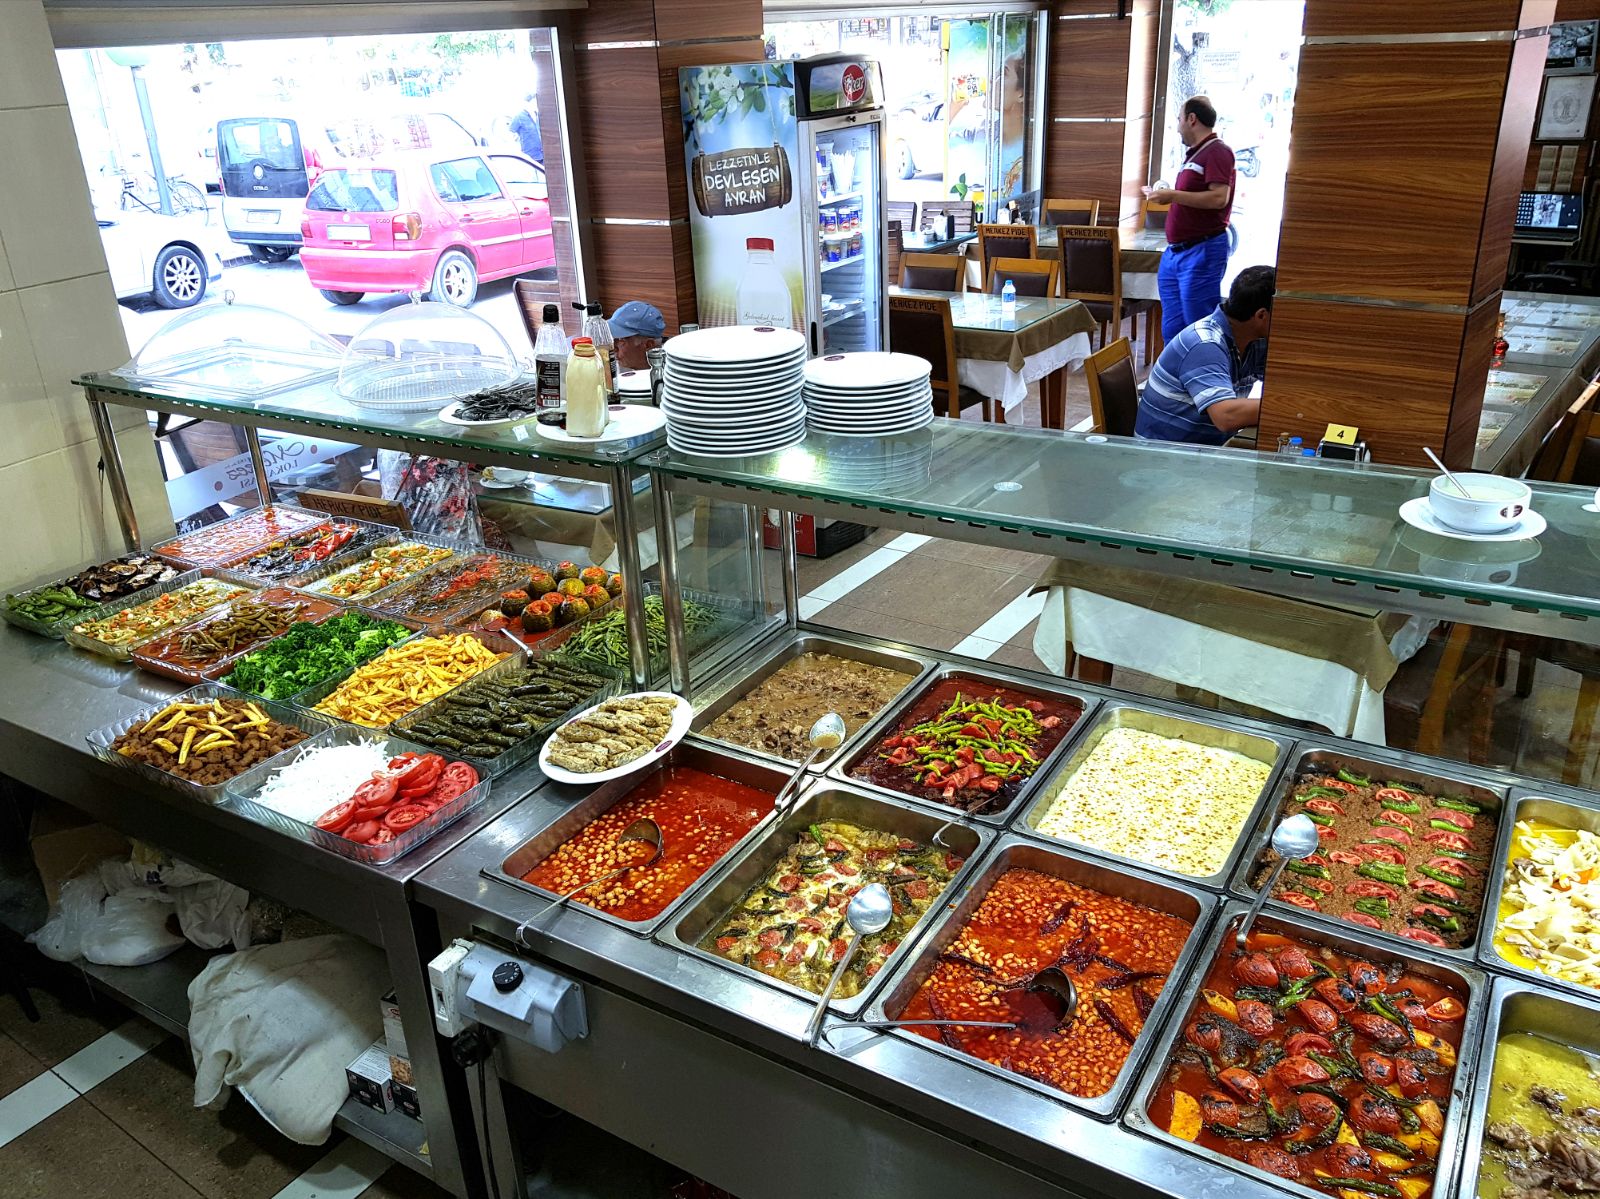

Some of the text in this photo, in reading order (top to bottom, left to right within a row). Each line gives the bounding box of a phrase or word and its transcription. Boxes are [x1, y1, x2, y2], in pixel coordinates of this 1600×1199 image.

[704, 165, 780, 191] DEVLEŞEN
[725, 188, 766, 207] AYRAN
[1336, 430, 1346, 440] 4
